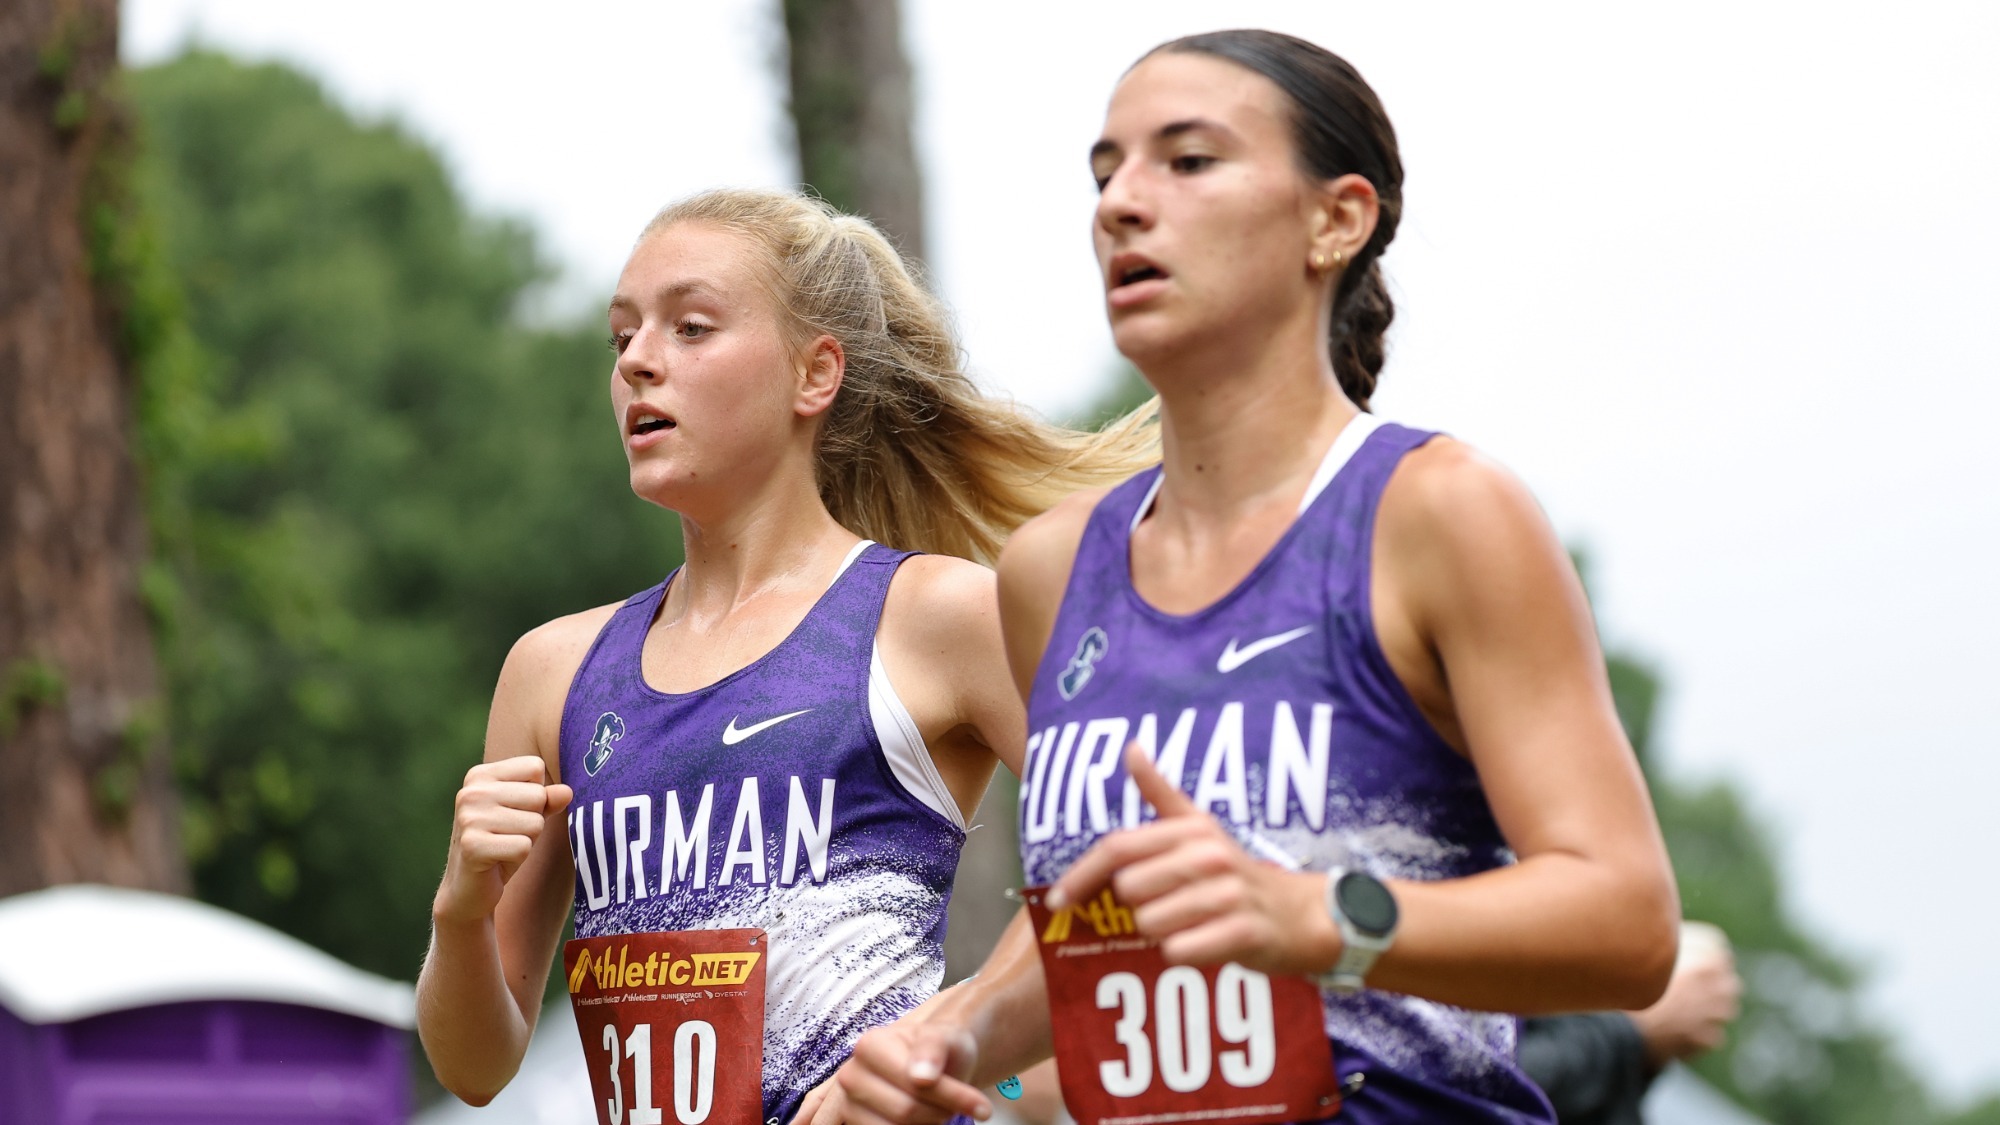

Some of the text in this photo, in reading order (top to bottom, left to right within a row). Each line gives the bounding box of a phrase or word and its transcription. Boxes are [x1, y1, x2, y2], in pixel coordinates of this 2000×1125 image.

[569, 943, 749, 993] Athletic NET
[602, 1019, 717, 1125] 310
[1095, 961, 1276, 1098] 309
